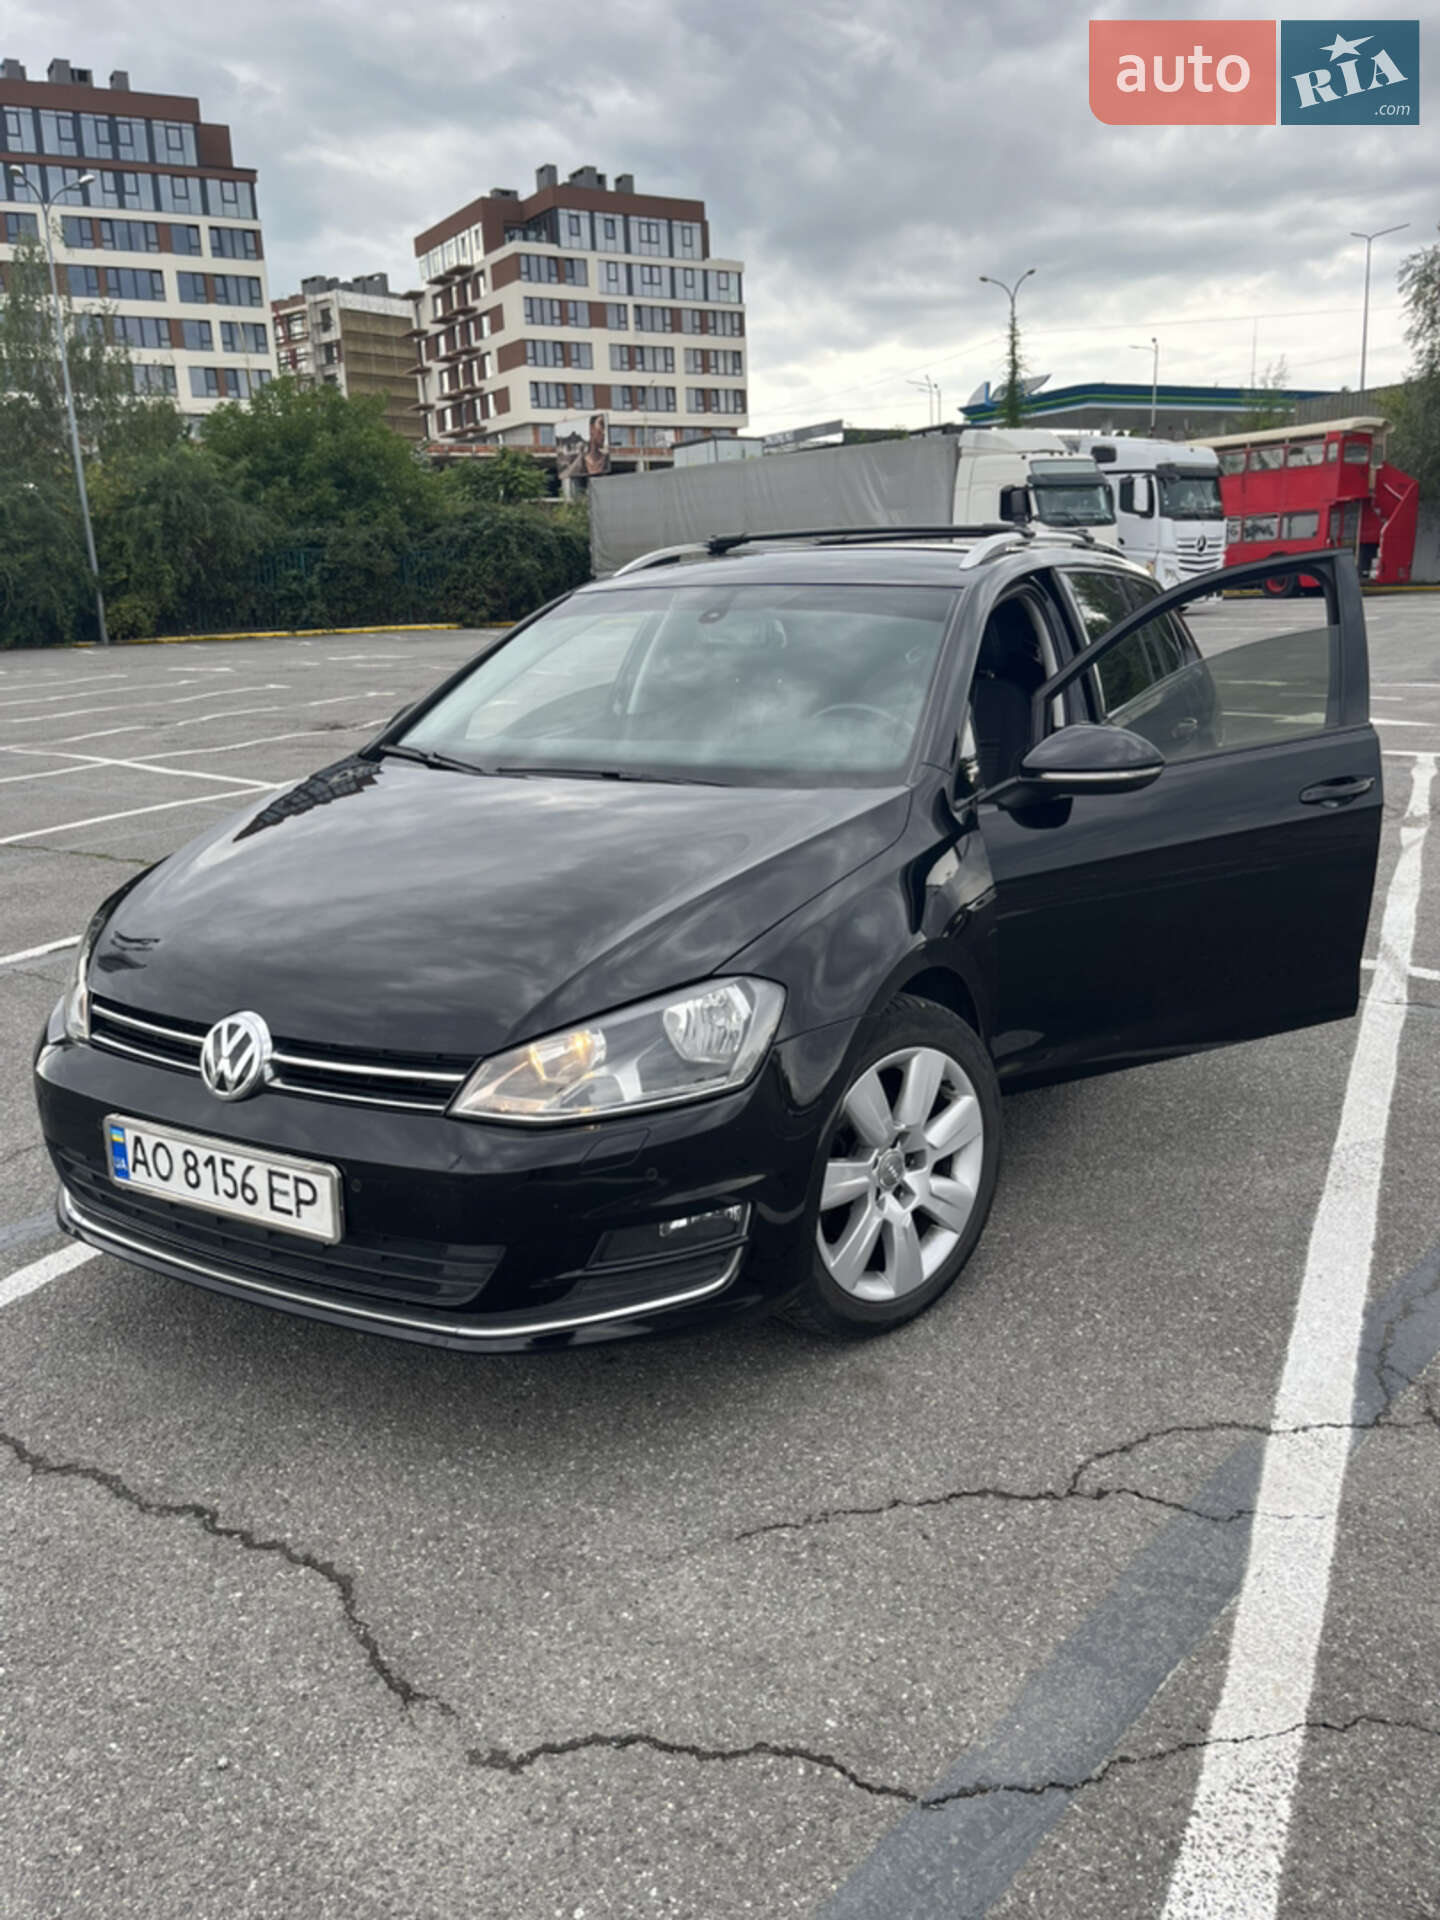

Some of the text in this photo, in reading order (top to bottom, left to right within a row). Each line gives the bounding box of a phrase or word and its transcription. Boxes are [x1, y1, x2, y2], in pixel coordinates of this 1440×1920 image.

[131, 1135, 318, 1218] AO 8156 EP
